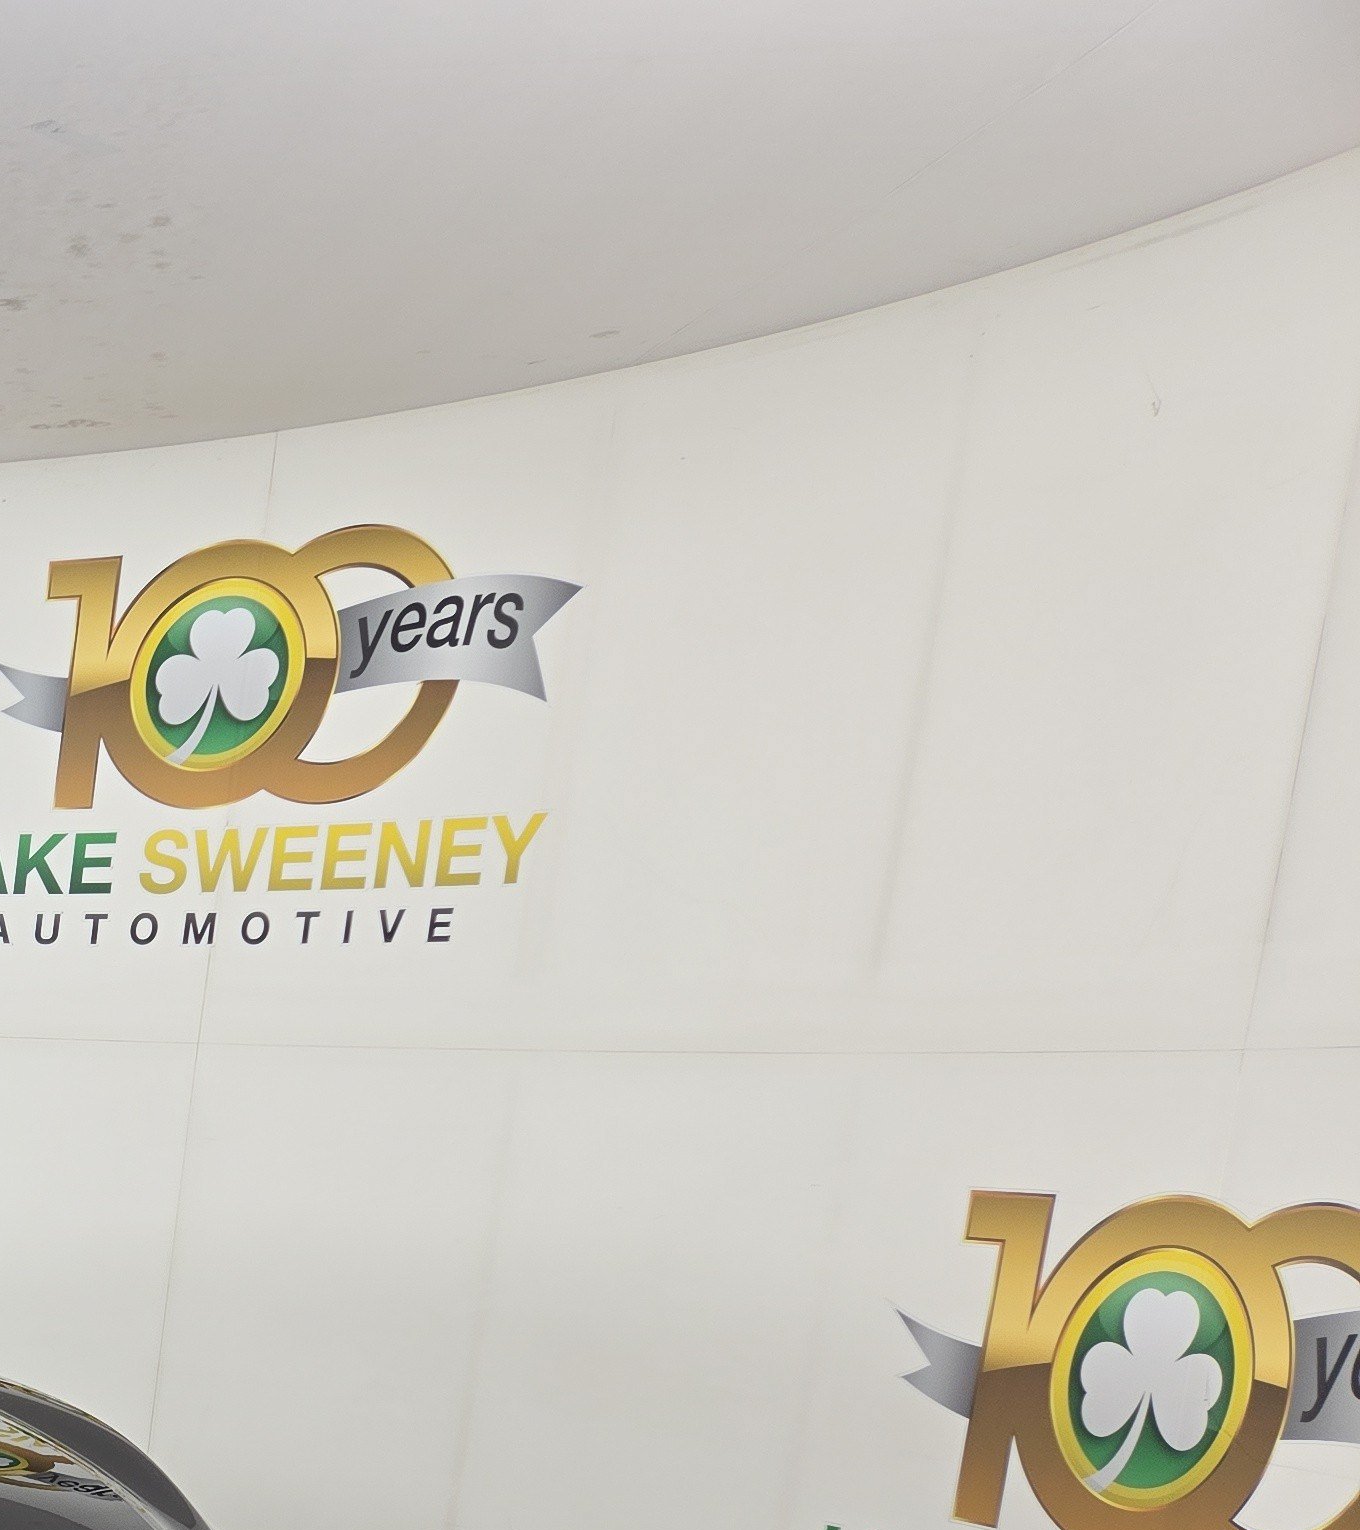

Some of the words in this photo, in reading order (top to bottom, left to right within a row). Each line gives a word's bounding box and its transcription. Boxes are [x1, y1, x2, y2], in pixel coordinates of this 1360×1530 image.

[47, 524, 460, 810] 100
[350, 590, 524, 679] years
[139, 812, 548, 895] SWEENEY
